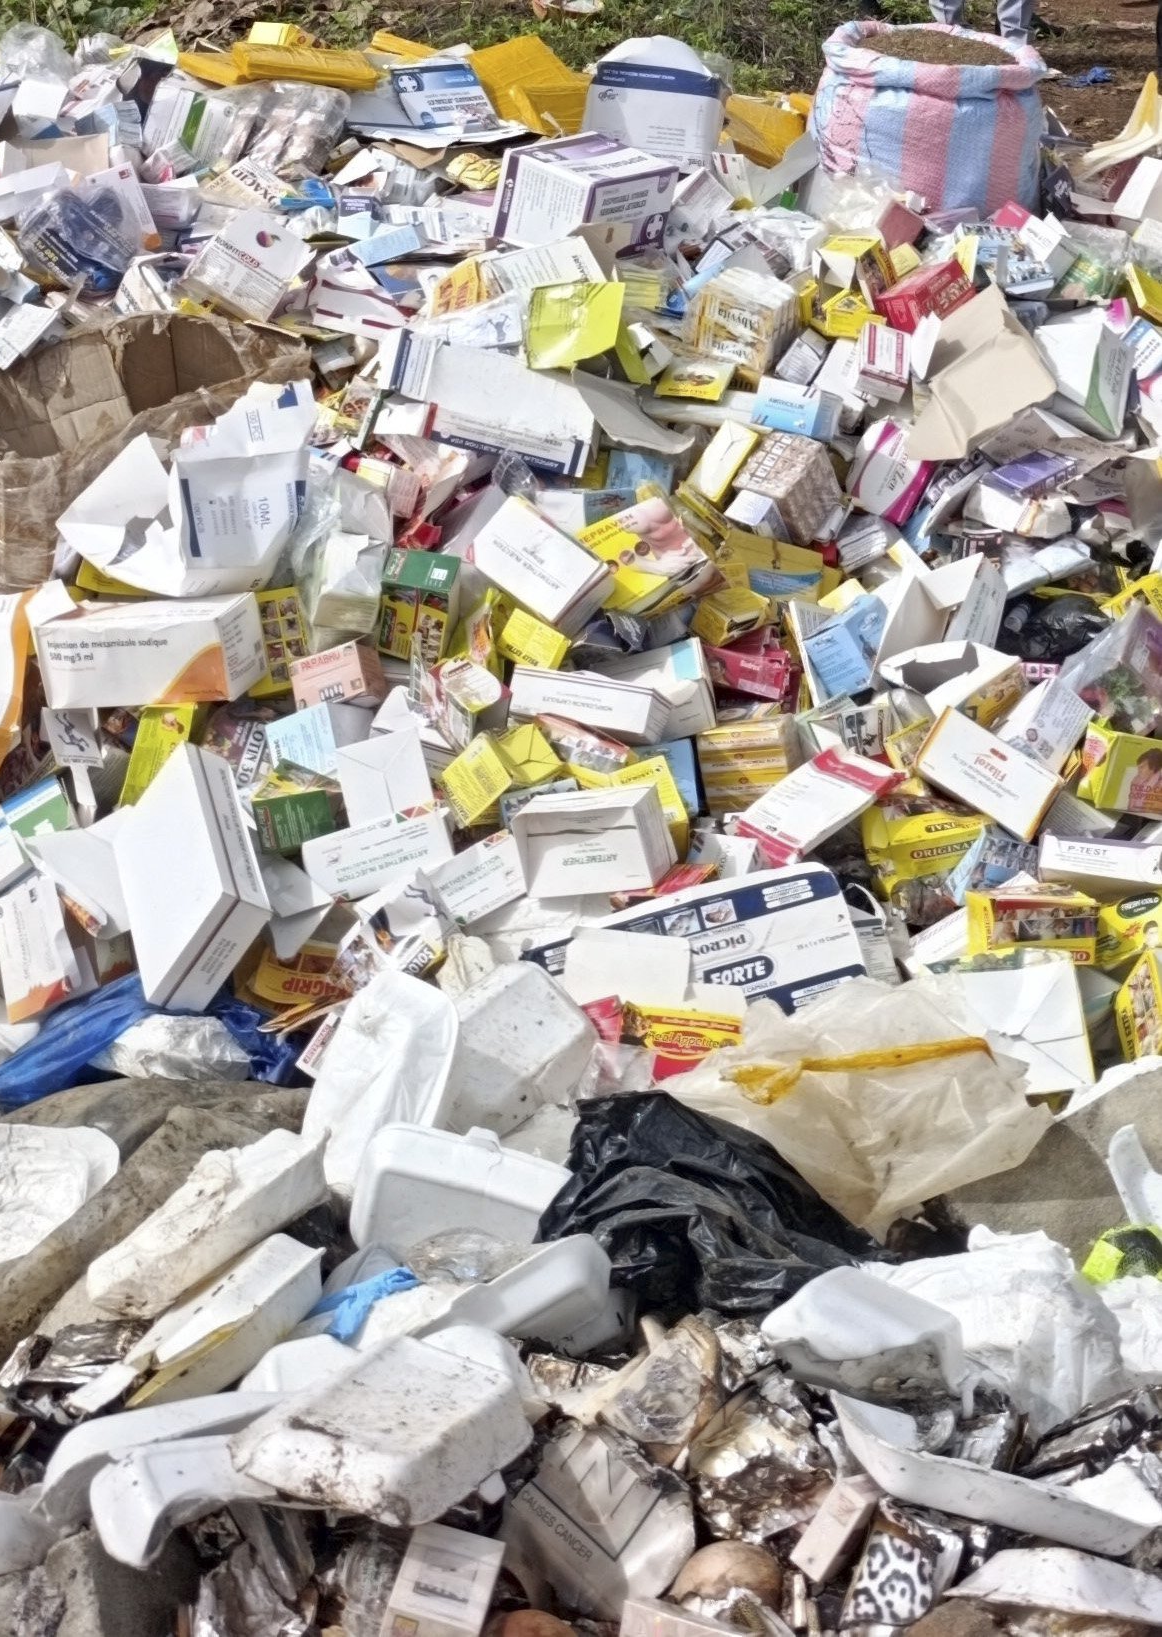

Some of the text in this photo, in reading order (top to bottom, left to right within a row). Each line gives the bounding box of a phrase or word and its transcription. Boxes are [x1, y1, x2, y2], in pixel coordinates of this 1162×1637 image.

[80, 639, 90, 649] de
[138, 638, 169, 648] sodique
[1068, 844, 1108, 857] P-TEST
[561, 853, 618, 867] ARTEMETHER
[710, 959, 766, 984] FORTE
[674, 1033, 720, 1049] Appetite
[521, 1490, 593, 1563] CAUSES CANCER
